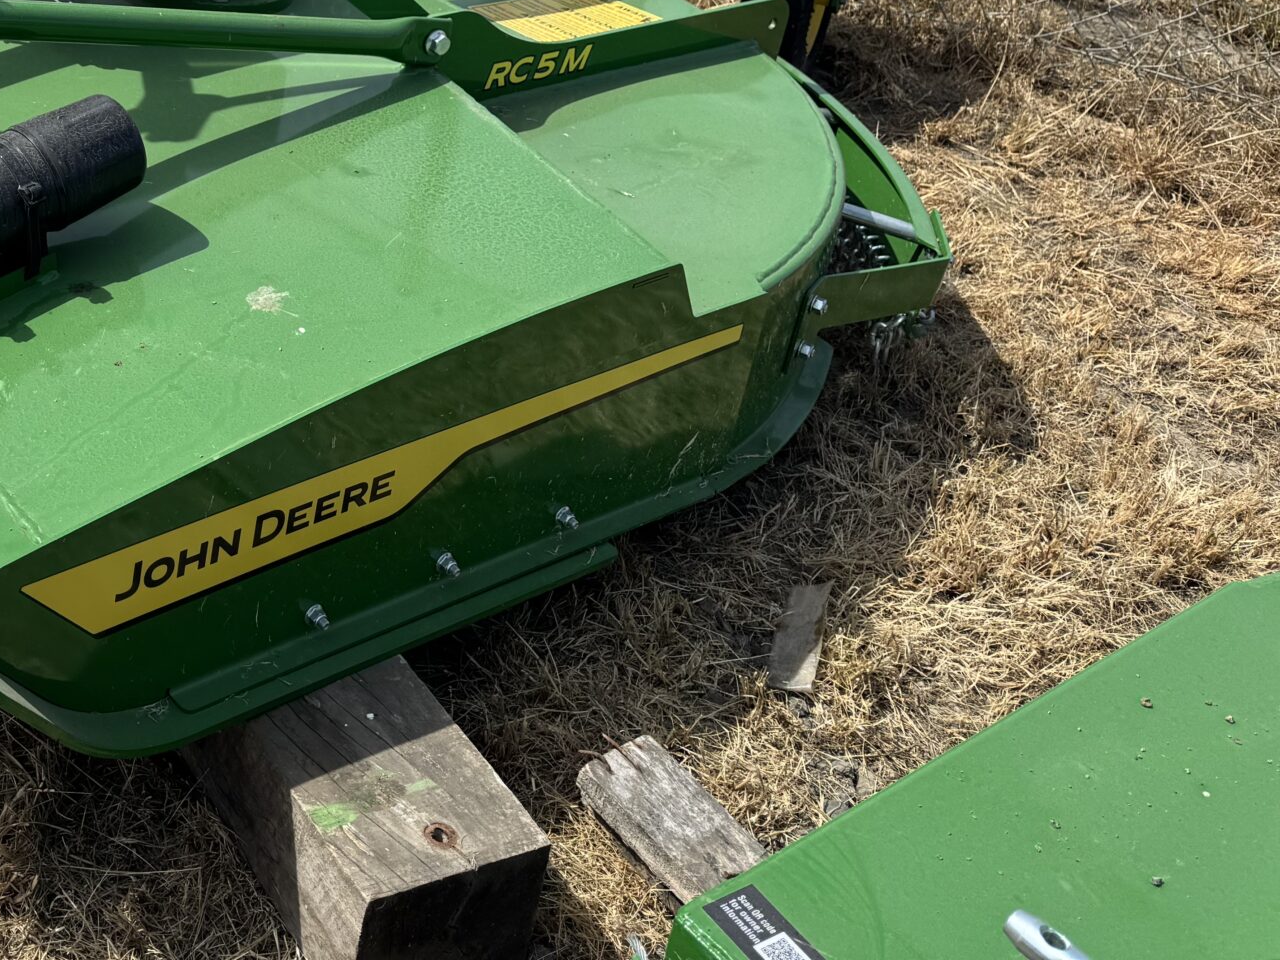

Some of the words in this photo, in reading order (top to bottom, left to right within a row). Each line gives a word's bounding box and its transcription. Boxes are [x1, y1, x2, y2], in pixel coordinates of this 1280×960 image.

[484, 44, 593, 90] RC5M
[114, 528, 242, 603] JOHN
[252, 470, 396, 548] DEERE
[720, 902, 761, 945] information
[728, 898, 742, 911] for
[740, 911, 764, 934] owner
[737, 894, 754, 911] Scan
[751, 909, 764, 921] QR
[760, 919, 777, 934] code
